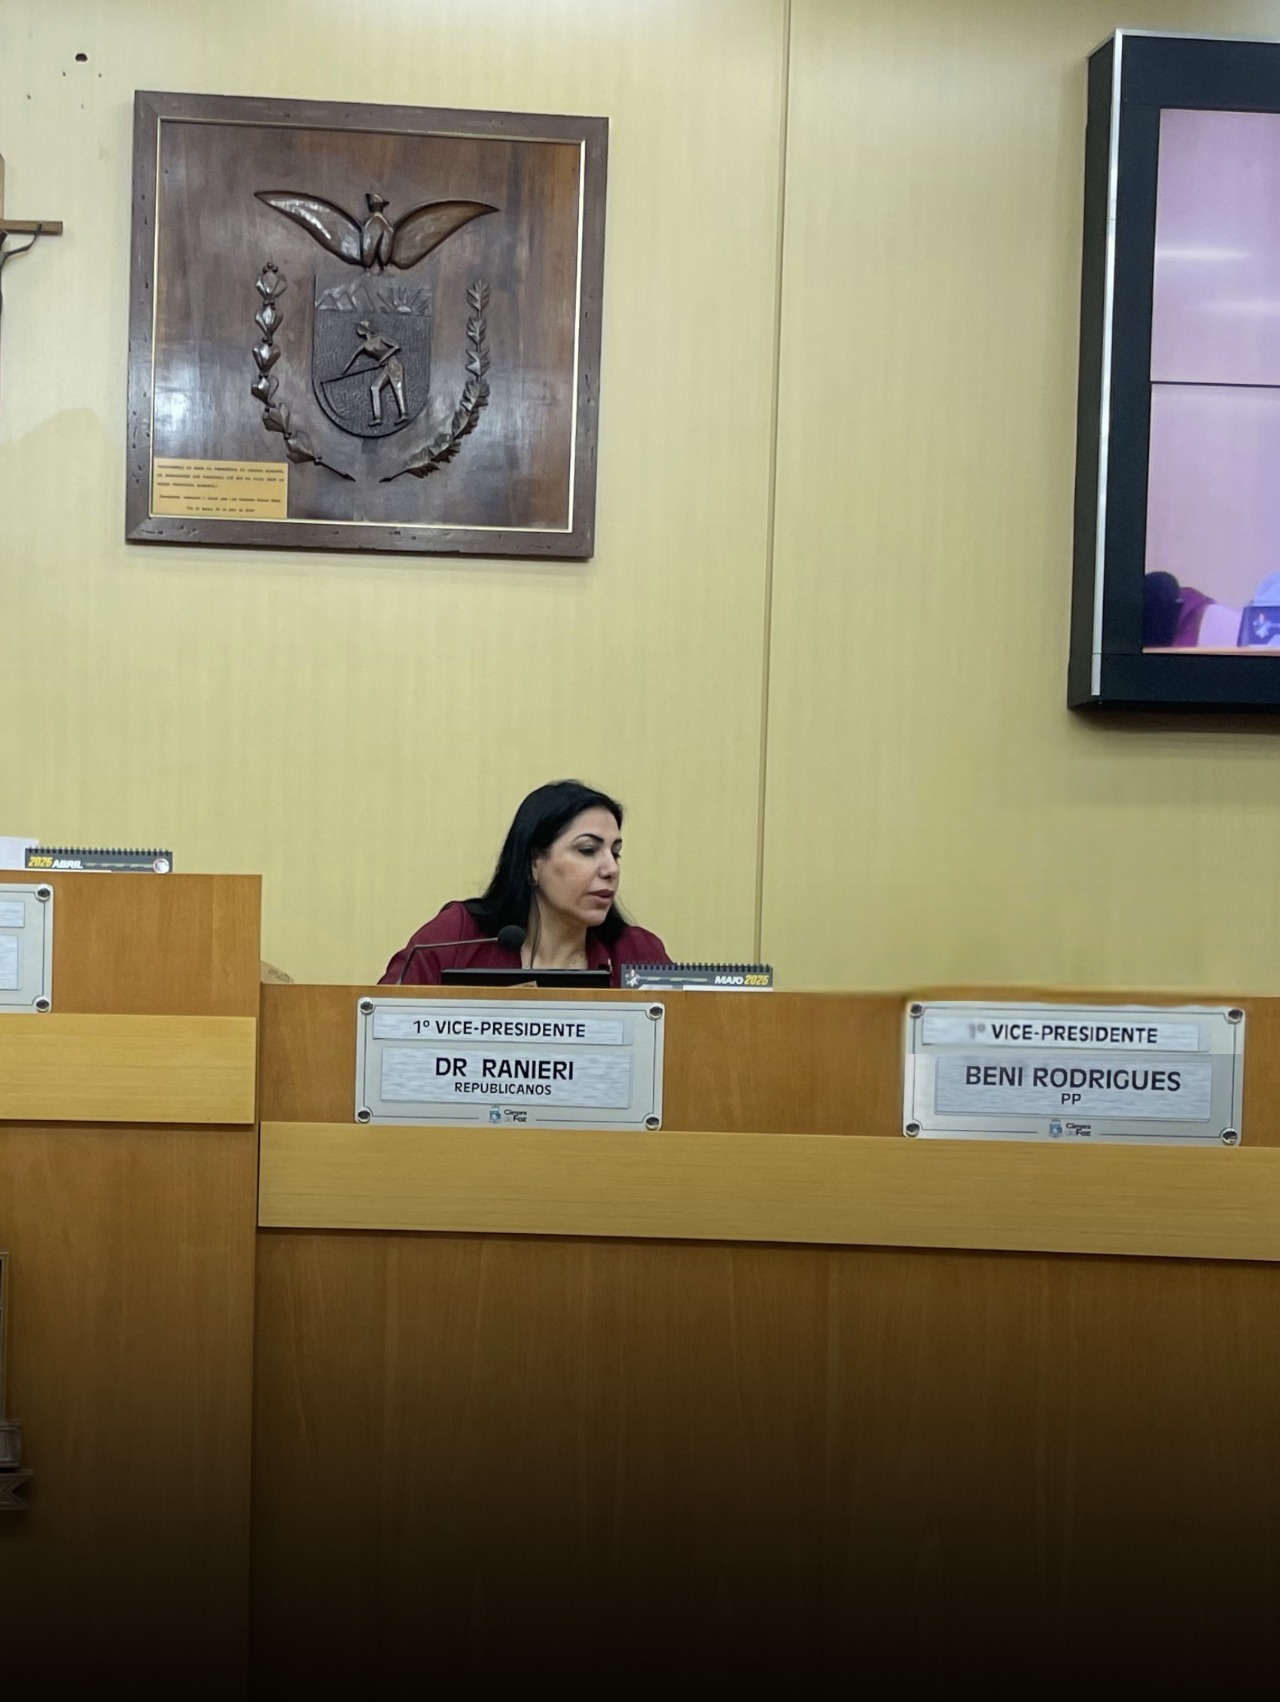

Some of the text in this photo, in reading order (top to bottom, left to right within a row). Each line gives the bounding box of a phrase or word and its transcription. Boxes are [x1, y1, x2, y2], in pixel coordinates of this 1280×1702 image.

[52, 859, 83, 869] ABRIL
[714, 976, 744, 985] MAIO
[436, 1020, 586, 1038] VICE-PRESIDENTE
[991, 1023, 1158, 1044] VICE-PRESIDENTE
[435, 1057, 574, 1081] DR RANIERI
[965, 1065, 1181, 1092] BENI RODRIGUES
[454, 1081, 552, 1097] REPUBLICANOS
[1061, 1093, 1082, 1106] PP
